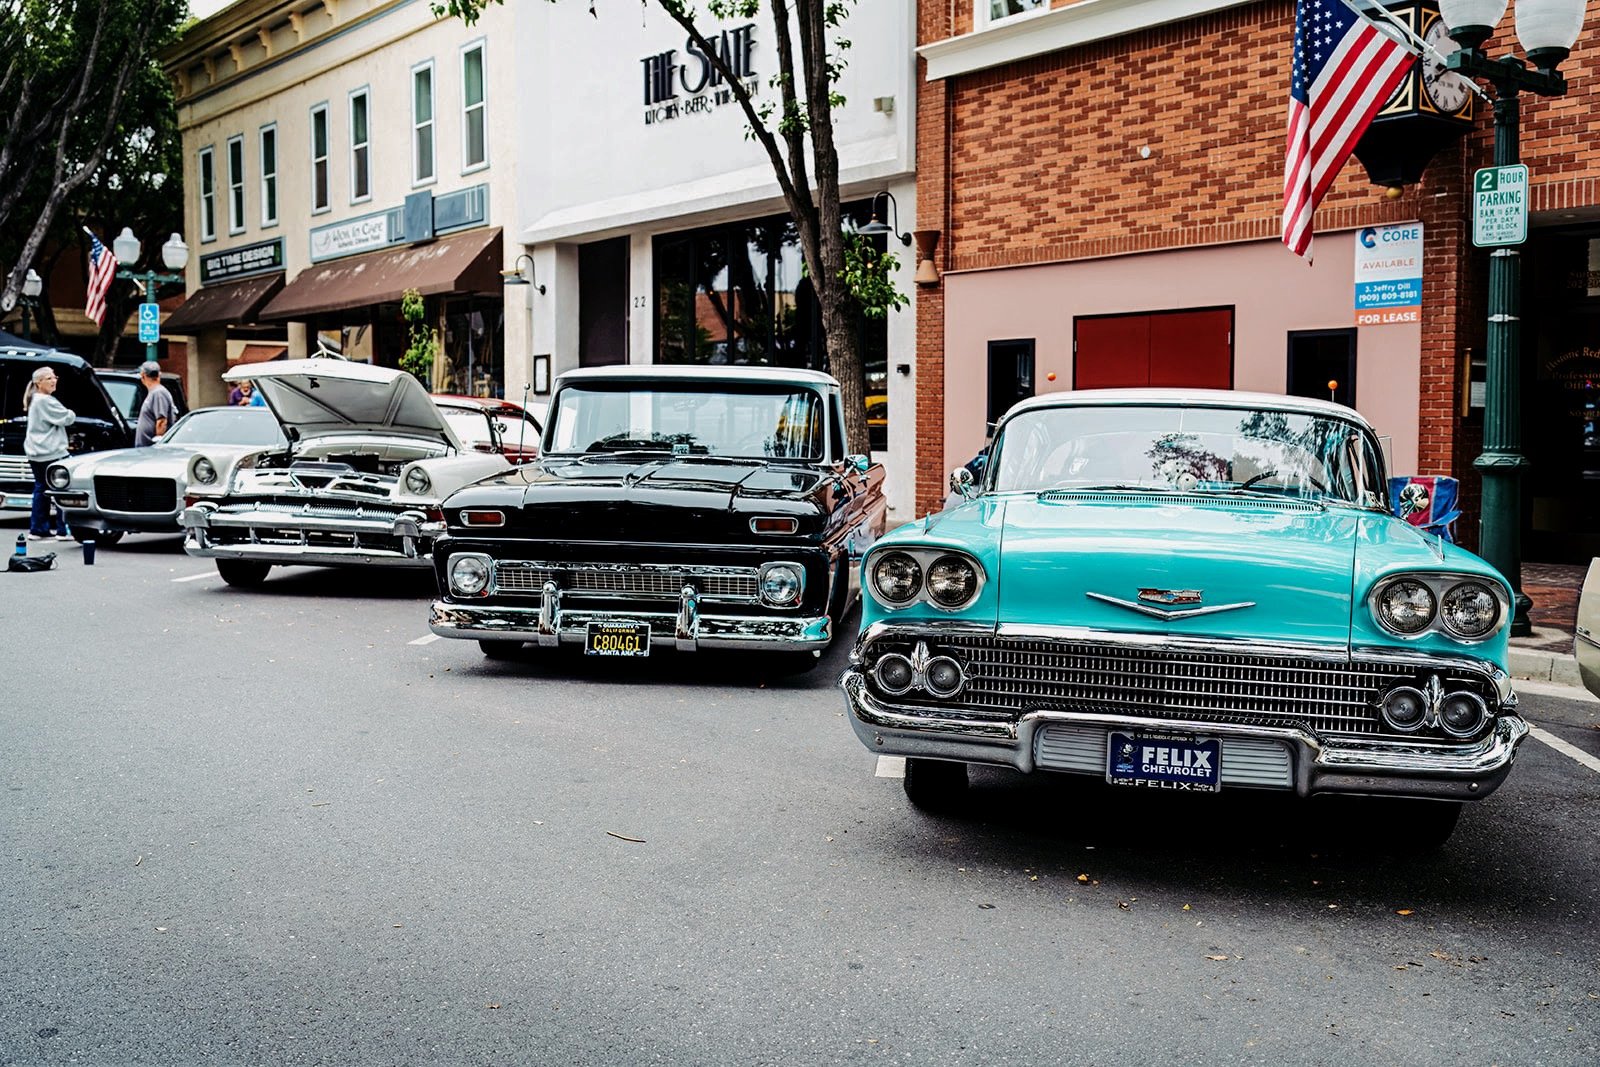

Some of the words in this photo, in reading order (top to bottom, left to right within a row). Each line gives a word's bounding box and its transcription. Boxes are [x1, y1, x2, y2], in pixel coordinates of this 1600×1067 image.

[640, 49, 679, 105] THE
[680, 23, 758, 94] STATE
[685, 95, 713, 115] BEER
[1481, 172, 1493, 190] 2
[1500, 171, 1524, 184] HOUR
[1480, 190, 1522, 207] PARKING
[1496, 222, 1518, 230] BLOCK
[1382, 228, 1419, 243] CORE
[207, 257, 221, 270] BIG
[221, 252, 242, 267] TIME
[242, 245, 275, 263] DESIGN
[1362, 257, 1415, 270] AVAILABLE
[1359, 294, 1380, 304] (909)
[1358, 314, 1381, 325] FOR
[1382, 311, 1418, 323] LEASE
[593, 634, 641, 652] C804G1
[1142, 746, 1212, 769] FELIX
[1141, 764, 1213, 778] CHEVROLET
[1135, 779, 1191, 791] FELIX
